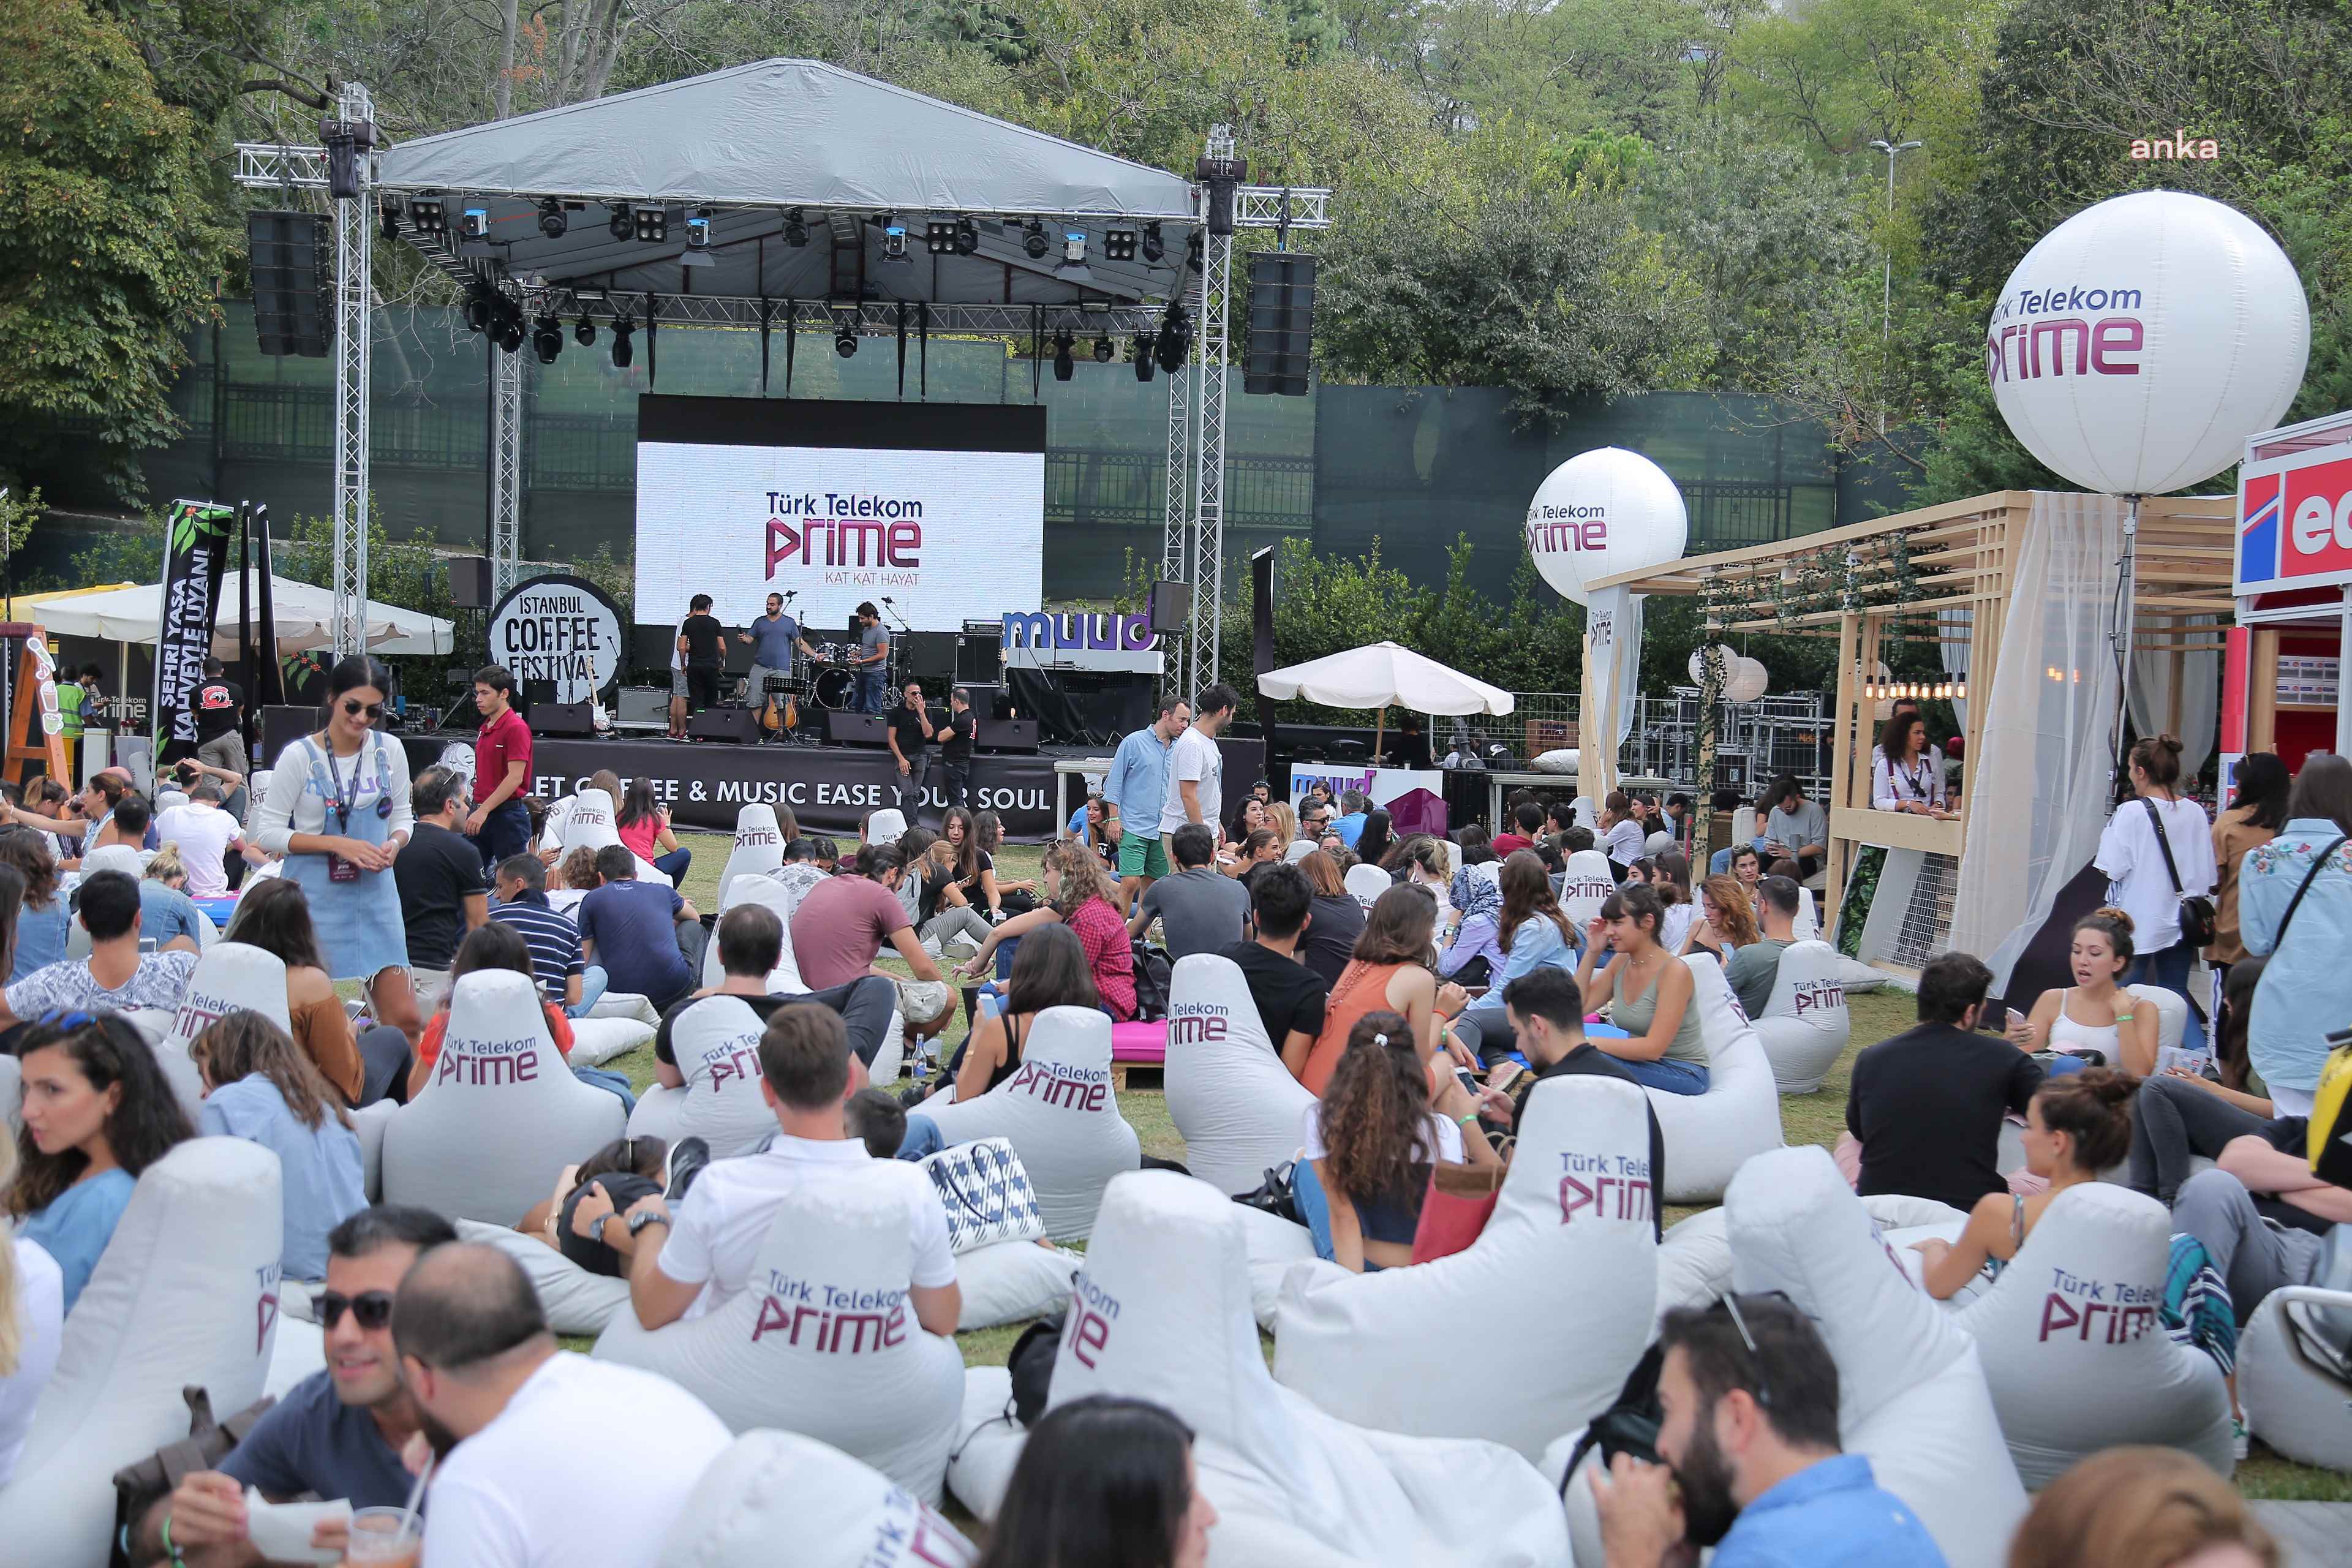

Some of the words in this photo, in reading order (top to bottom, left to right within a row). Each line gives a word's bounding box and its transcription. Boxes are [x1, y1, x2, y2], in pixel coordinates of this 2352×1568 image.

[2019, 285, 2141, 315] Telekom
[766, 492, 816, 514] Türk
[825, 494, 922, 518] Telekom
[1543, 505, 1604, 519] Telekom
[765, 518, 922, 581] prime
[826, 572, 850, 584] KAT
[853, 573, 877, 586] KAT
[881, 573, 920, 586] HAYAT
[167, 578, 187, 638] YAŞA
[519, 595, 584, 614] İSTANBUL
[505, 617, 600, 653] COFFEE
[1003, 595, 1159, 650] muud
[161, 644, 179, 707] ŞEHRİ
[173, 628, 201, 741] KAHVEYLE
[689, 780, 707, 802] &
[716, 780, 807, 804] MUSIC
[816, 783, 881, 805] EASE
[978, 788, 1050, 810] SOUL
[735, 832, 777, 852] prime
[1566, 883, 1613, 902] prime
[1793, 981, 1817, 992] Türk
[1174, 1001, 1229, 1016] Telekom
[470, 1036, 537, 1054] Telekom
[1168, 1017, 1227, 1046] rime
[701, 1041, 736, 1064] Türk
[438, 1049, 538, 1087] prime
[1052, 1062, 1108, 1082] Telekom
[1009, 1061, 1106, 1111] prime
[1560, 1152, 1609, 1174] Türk
[771, 1268, 813, 1302] Türk
[2054, 1267, 2105, 1300] Türk
[752, 1295, 907, 1354] prime
